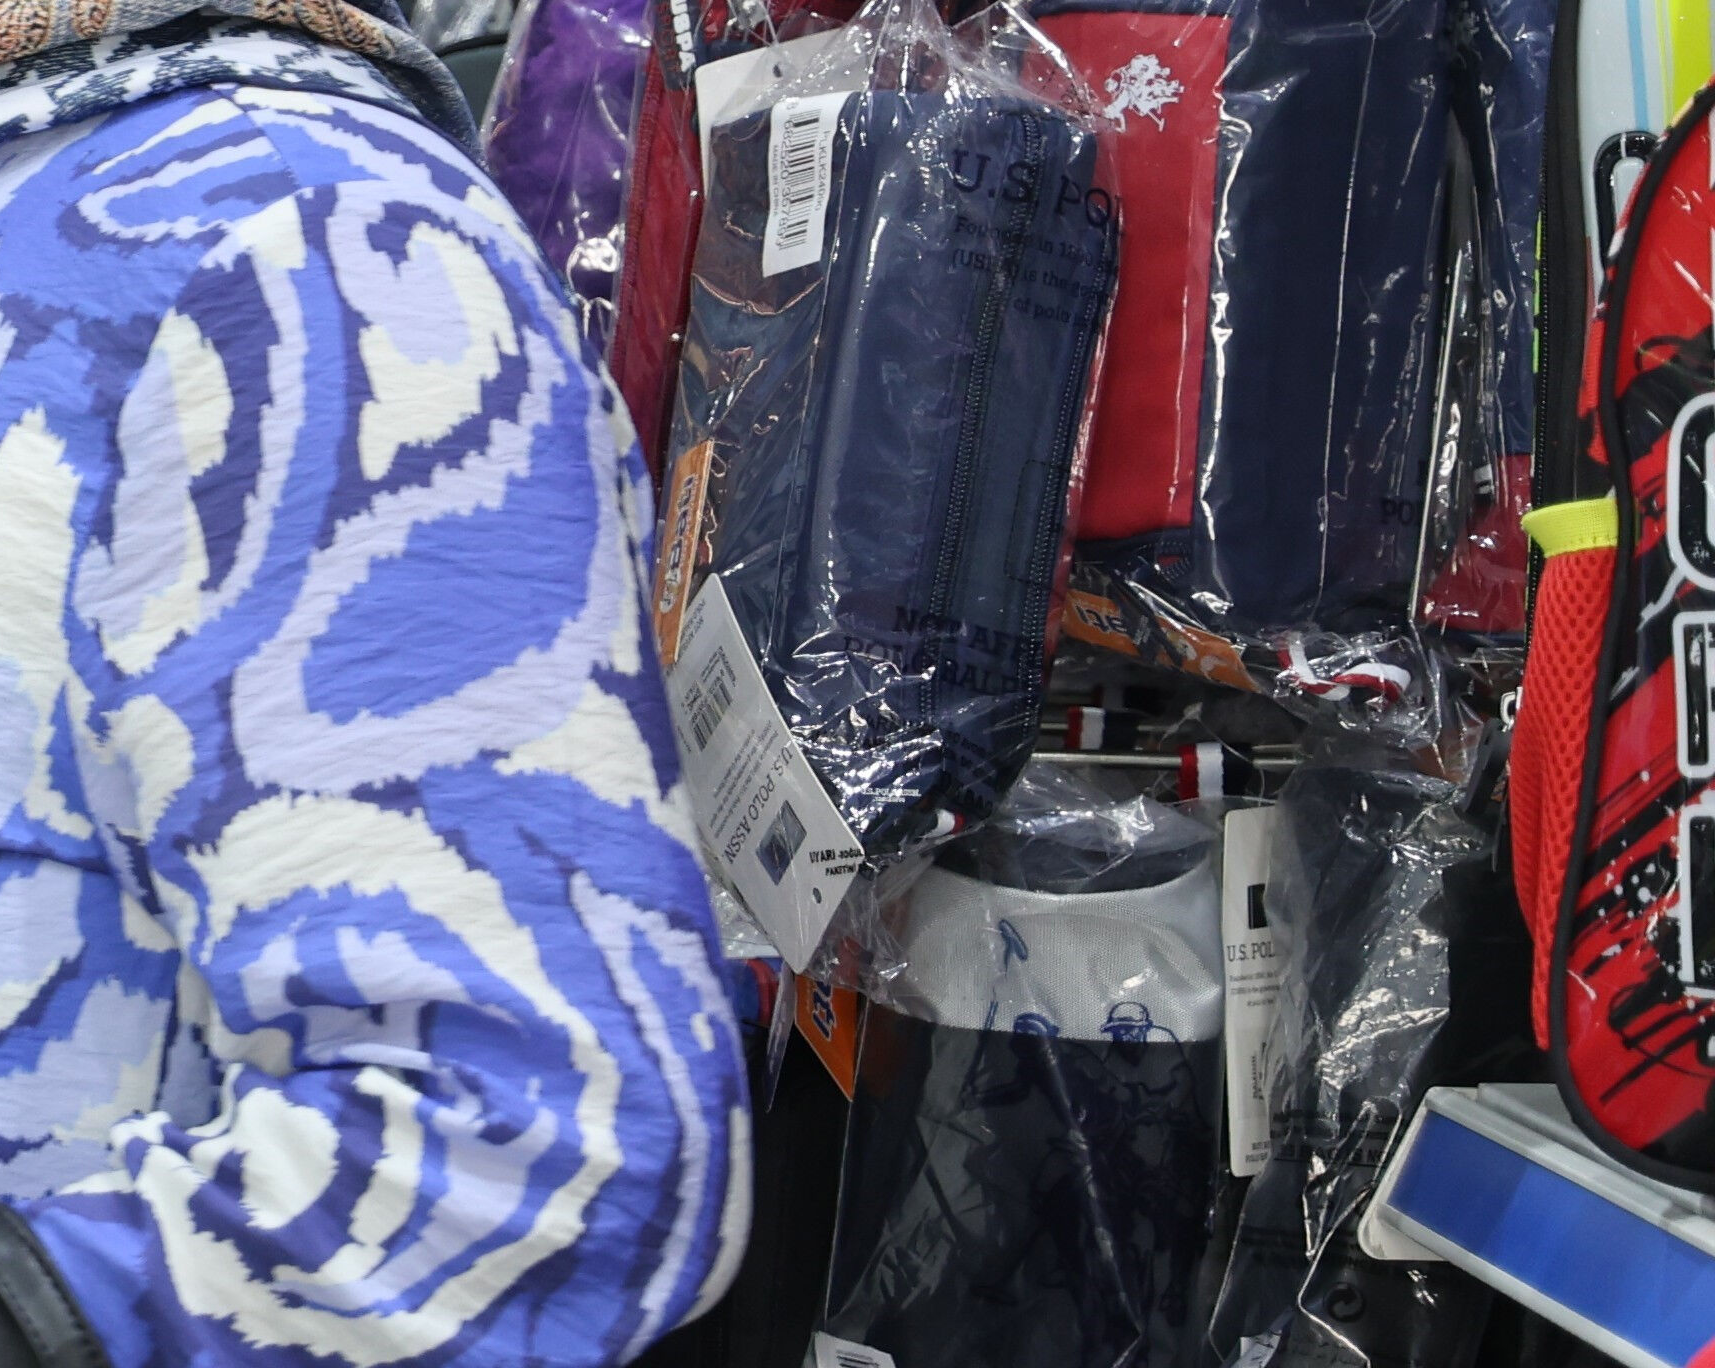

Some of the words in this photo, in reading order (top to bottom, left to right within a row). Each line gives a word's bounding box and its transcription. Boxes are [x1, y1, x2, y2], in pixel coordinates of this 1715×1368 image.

[748, 779, 777, 822] POLO
[1227, 942, 1249, 962] U.S.
[1251, 941, 1276, 960] POL
